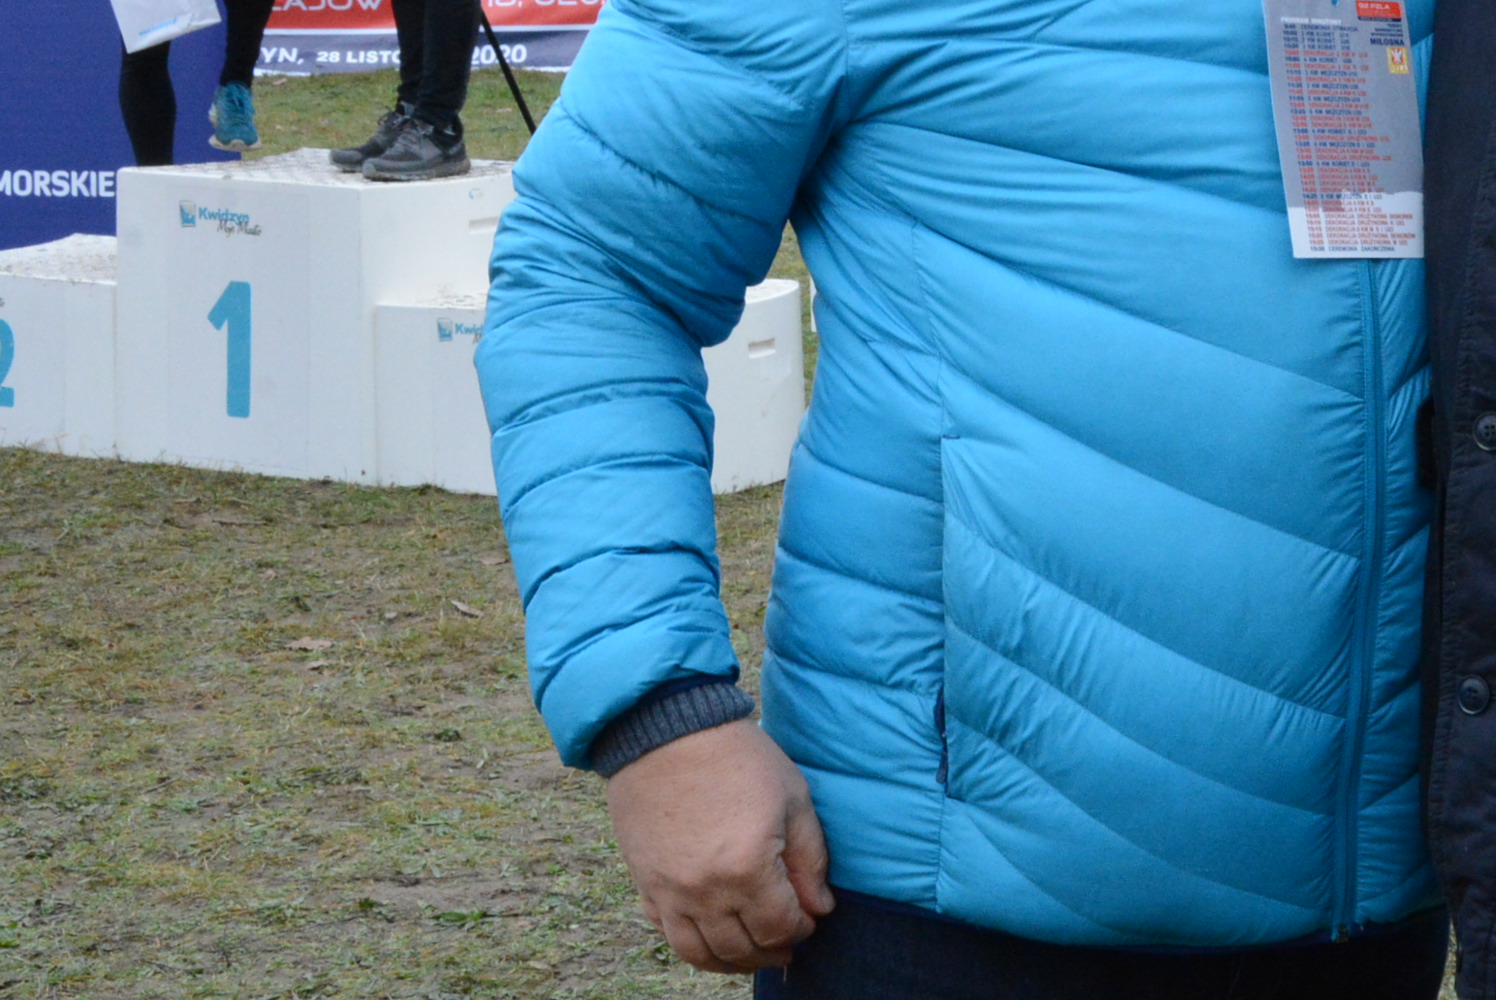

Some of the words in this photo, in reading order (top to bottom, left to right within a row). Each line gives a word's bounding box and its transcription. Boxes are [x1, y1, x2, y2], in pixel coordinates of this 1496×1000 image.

[316, 51, 341, 63] 28
[198, 206, 250, 226] Kwidzyn
[206, 279, 253, 419] 1
